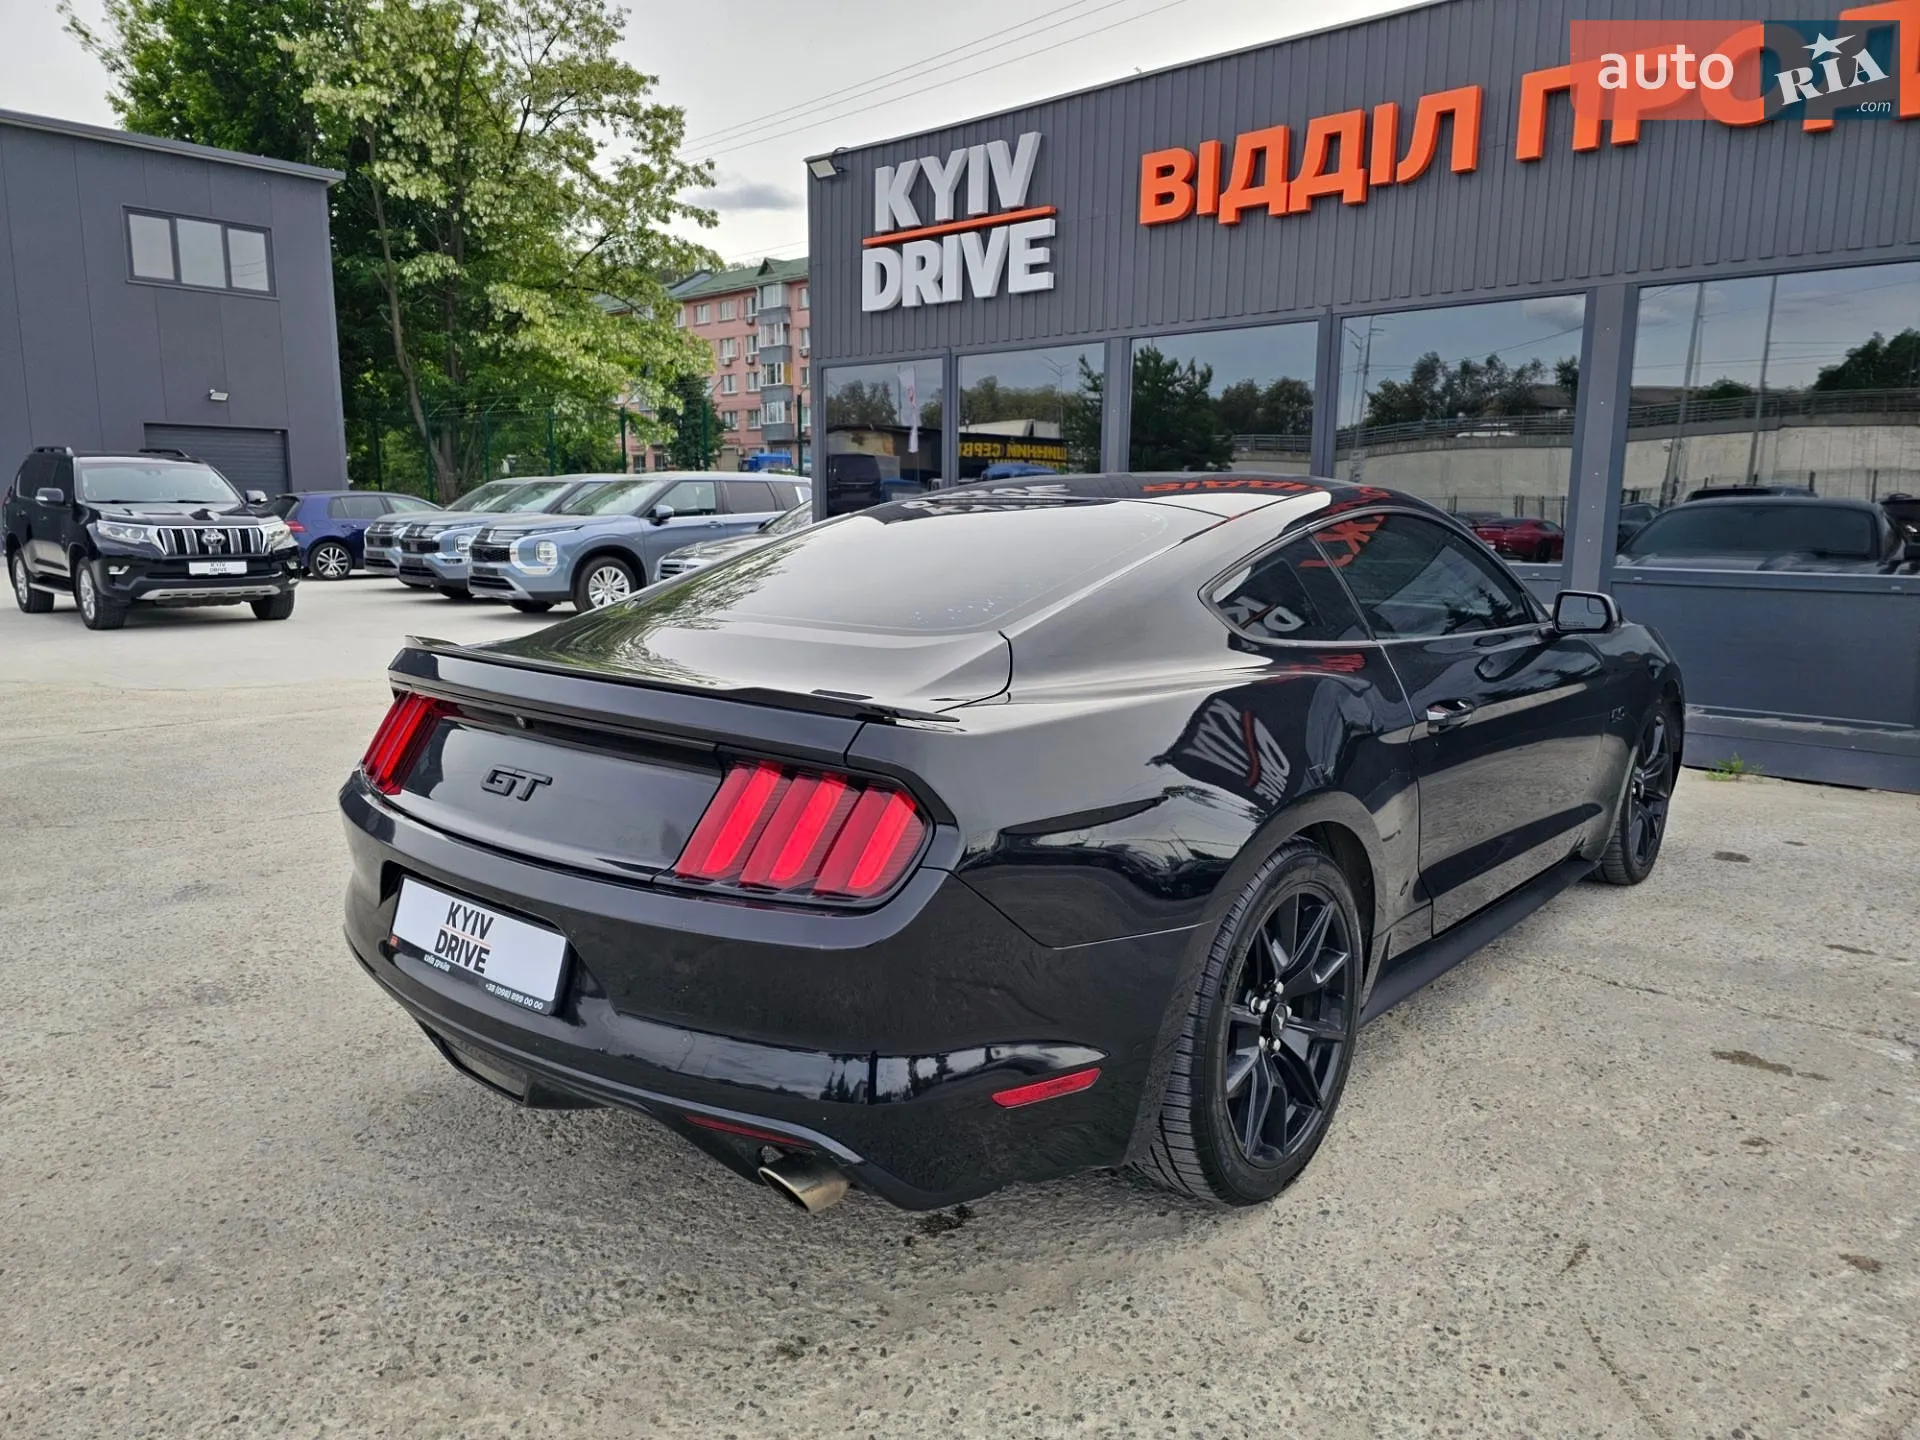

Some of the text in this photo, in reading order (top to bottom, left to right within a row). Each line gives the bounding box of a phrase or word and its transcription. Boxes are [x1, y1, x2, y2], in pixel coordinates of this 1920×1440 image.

[1139, 85, 1483, 228] ВІДДІЛ
[874, 131, 1043, 232] KYIV
[862, 218, 1055, 312] DRIVE
[480, 764, 552, 802] GT
[446, 901, 494, 940] KYIV
[434, 928, 491, 974] DRIVE
[523, 996, 534, 1007] 00
[533, 1001, 544, 1011] 00
